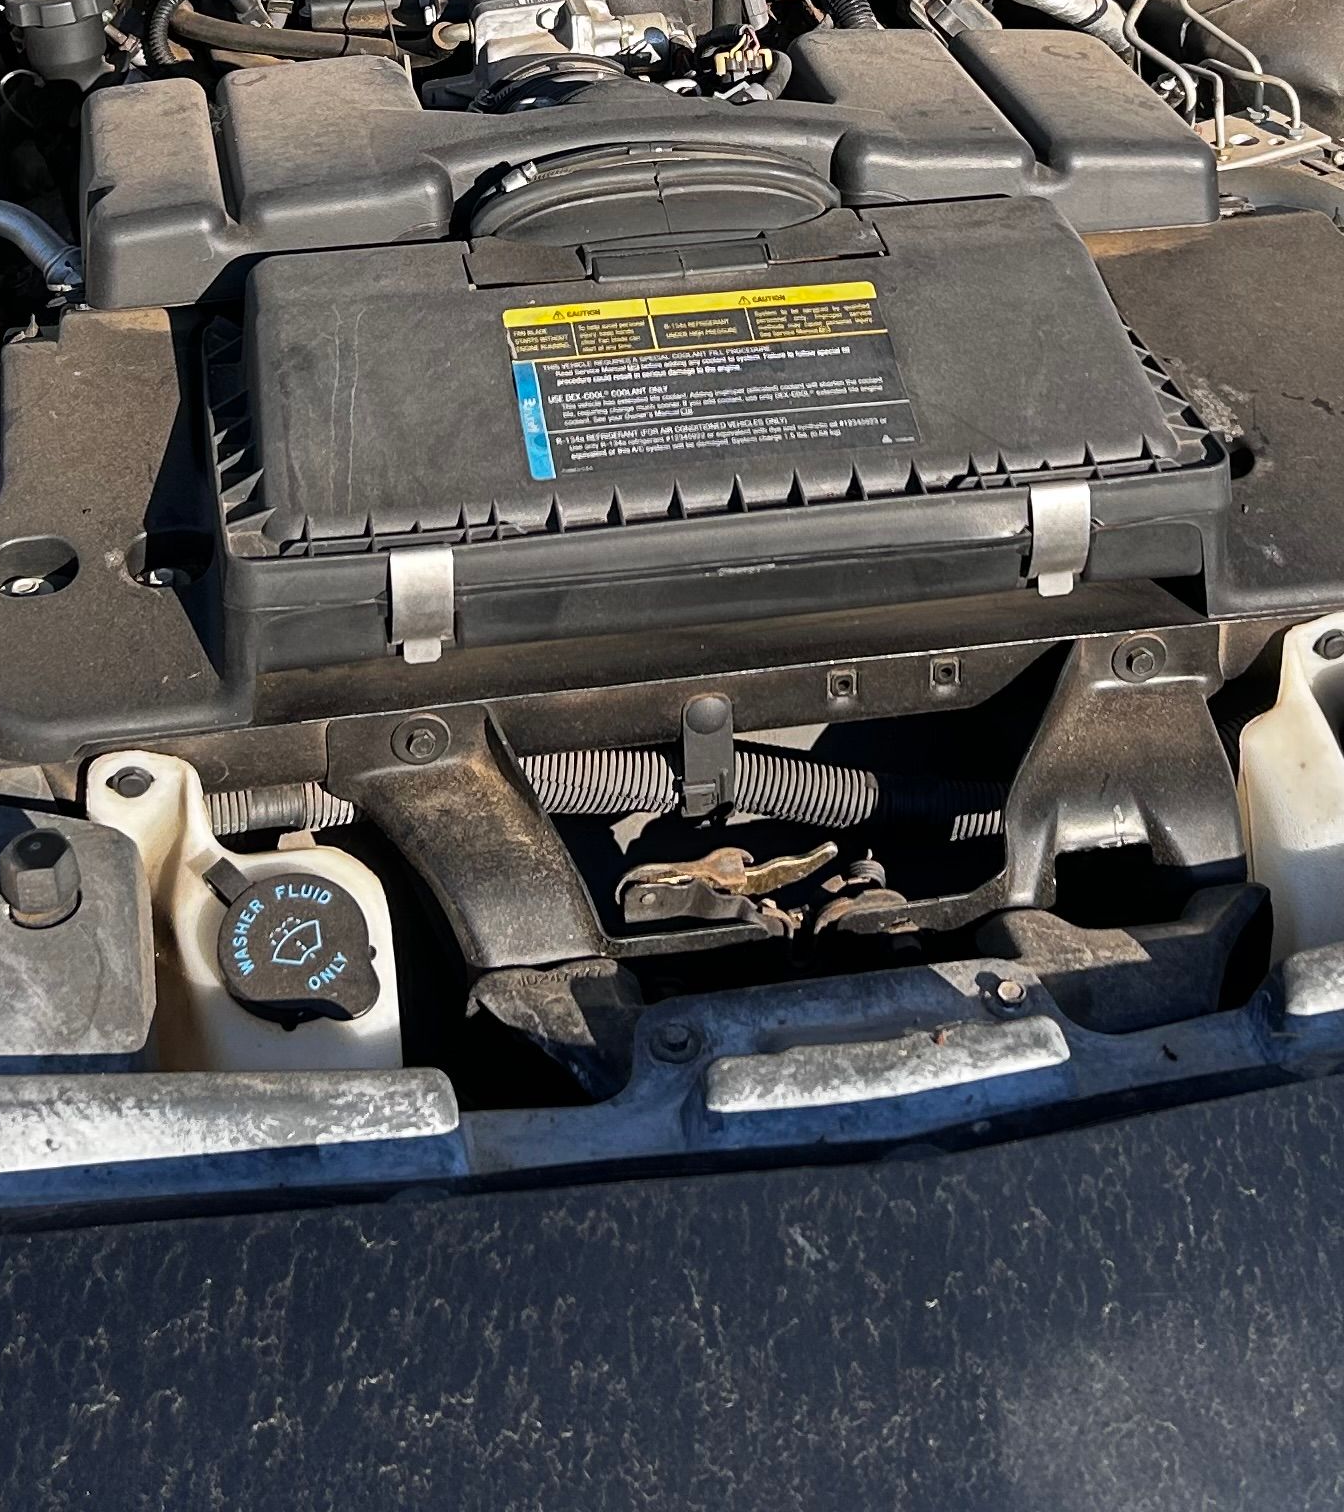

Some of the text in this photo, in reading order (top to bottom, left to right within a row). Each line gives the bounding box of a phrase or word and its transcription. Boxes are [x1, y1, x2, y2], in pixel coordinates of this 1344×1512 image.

[752, 294, 785, 303] CAUTION
[566, 309, 600, 317] CAUTION
[547, 394, 563, 403] USE
[610, 387, 646, 397] COOLANT
[647, 385, 668, 393] ONLY
[585, 429, 638, 442] REFRIGERANT
[232, 884, 348, 990] WASHER FLUID ONLY
